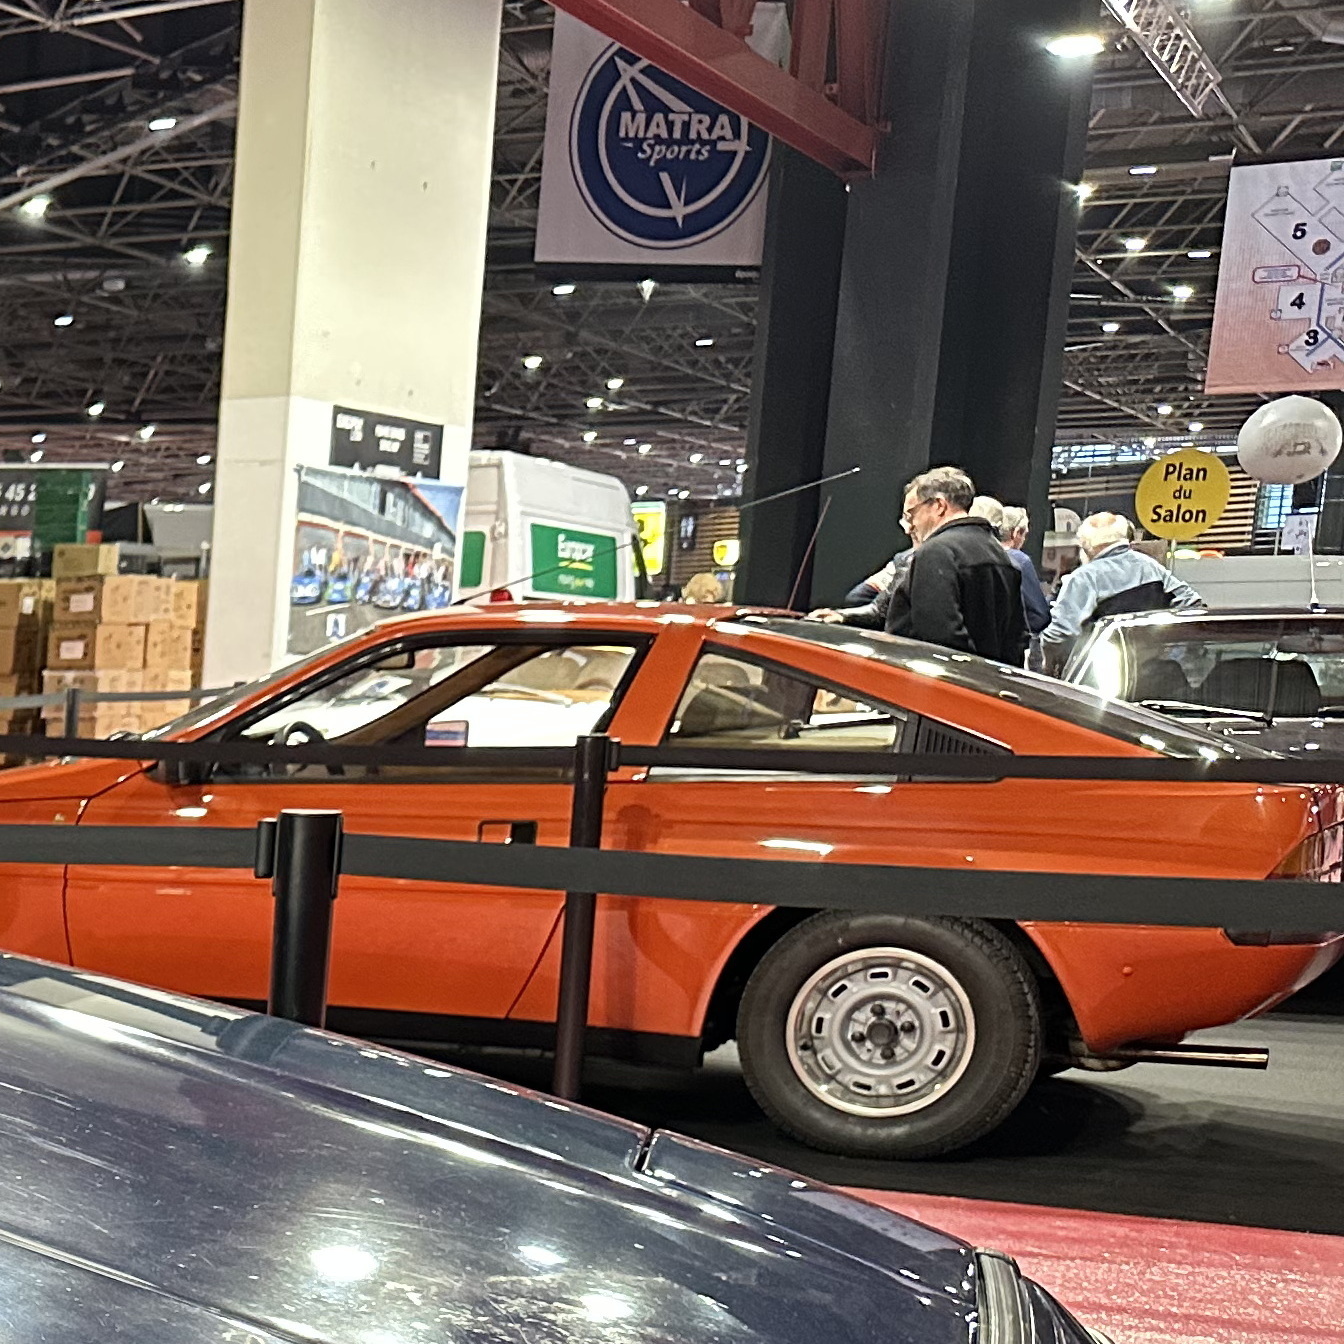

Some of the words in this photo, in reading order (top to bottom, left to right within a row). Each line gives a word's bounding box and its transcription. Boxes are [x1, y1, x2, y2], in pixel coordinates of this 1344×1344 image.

[619, 111, 734, 140] MATRA
[637, 140, 711, 167] Sports
[1291, 222, 1307, 239] 5
[1290, 292, 1306, 310] 4
[1304, 329, 1319, 346] 3
[1163, 462, 1208, 482] Plan
[4, 483, 26, 502] 45
[1172, 485, 1193, 500] du
[1150, 504, 1207, 523] Salon
